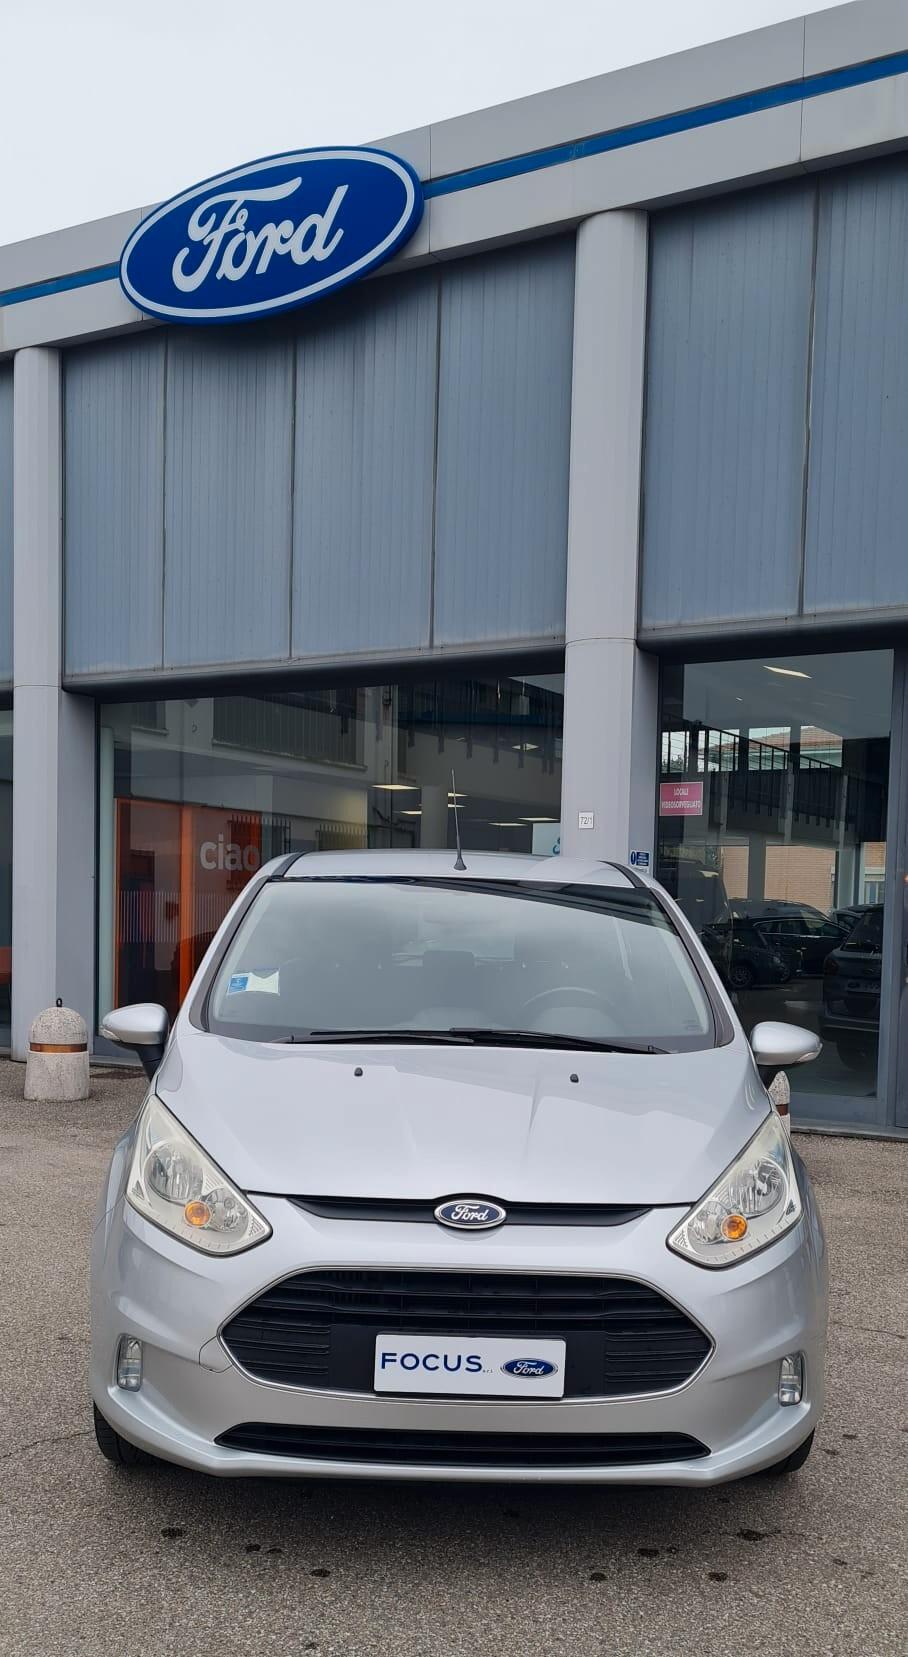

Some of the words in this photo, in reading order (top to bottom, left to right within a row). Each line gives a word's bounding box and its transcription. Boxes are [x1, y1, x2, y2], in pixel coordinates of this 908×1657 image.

[172, 176, 349, 293] Ford
[200, 832, 261, 871] ciao
[451, 1204, 490, 1221] Ford
[381, 1352, 483, 1373] FOCUS
[512, 1361, 545, 1376] Ford
